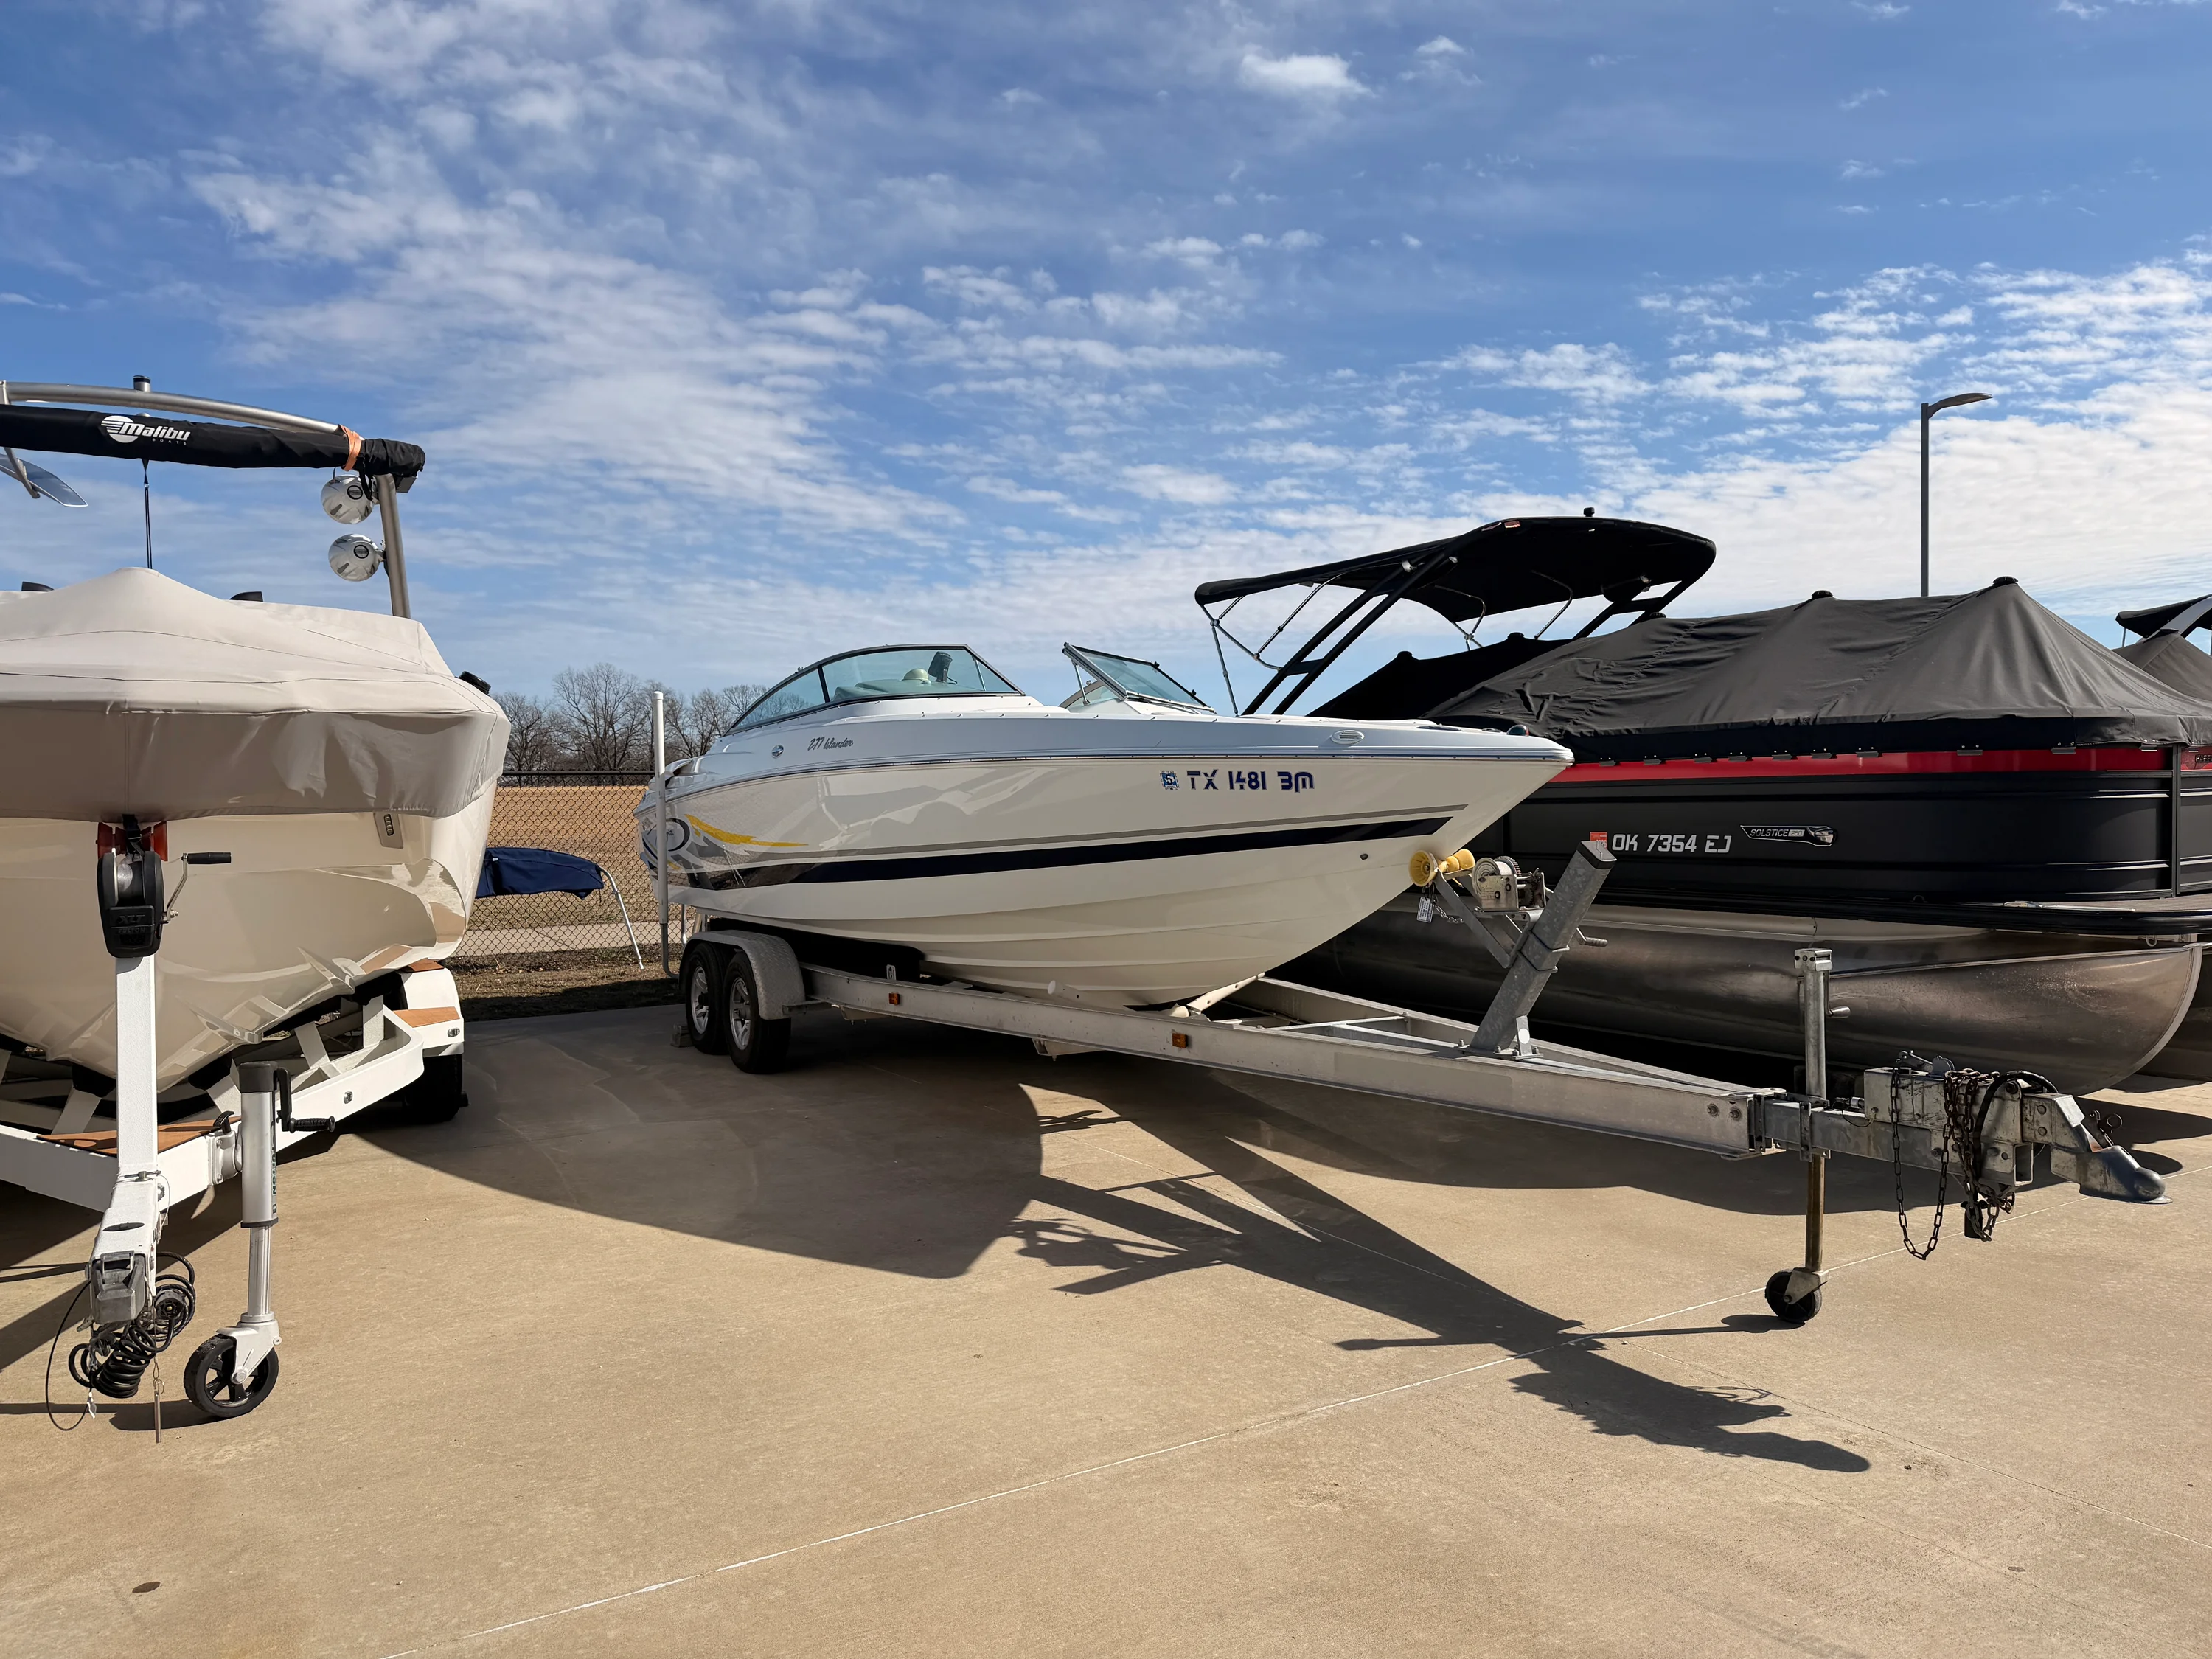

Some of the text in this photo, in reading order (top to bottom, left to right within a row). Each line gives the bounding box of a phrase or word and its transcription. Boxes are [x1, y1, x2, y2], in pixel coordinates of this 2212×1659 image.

[119, 422, 190, 441] Malibu
[823, 737, 854, 750] Islander
[1186, 768, 1219, 790] TX
[1228, 771, 1267, 790] 1481
[1750, 829, 1789, 837] SOLSTICE
[1612, 834, 1639, 851] OK
[1646, 834, 1697, 852] 7354
[1705, 835, 1732, 853] EJ
